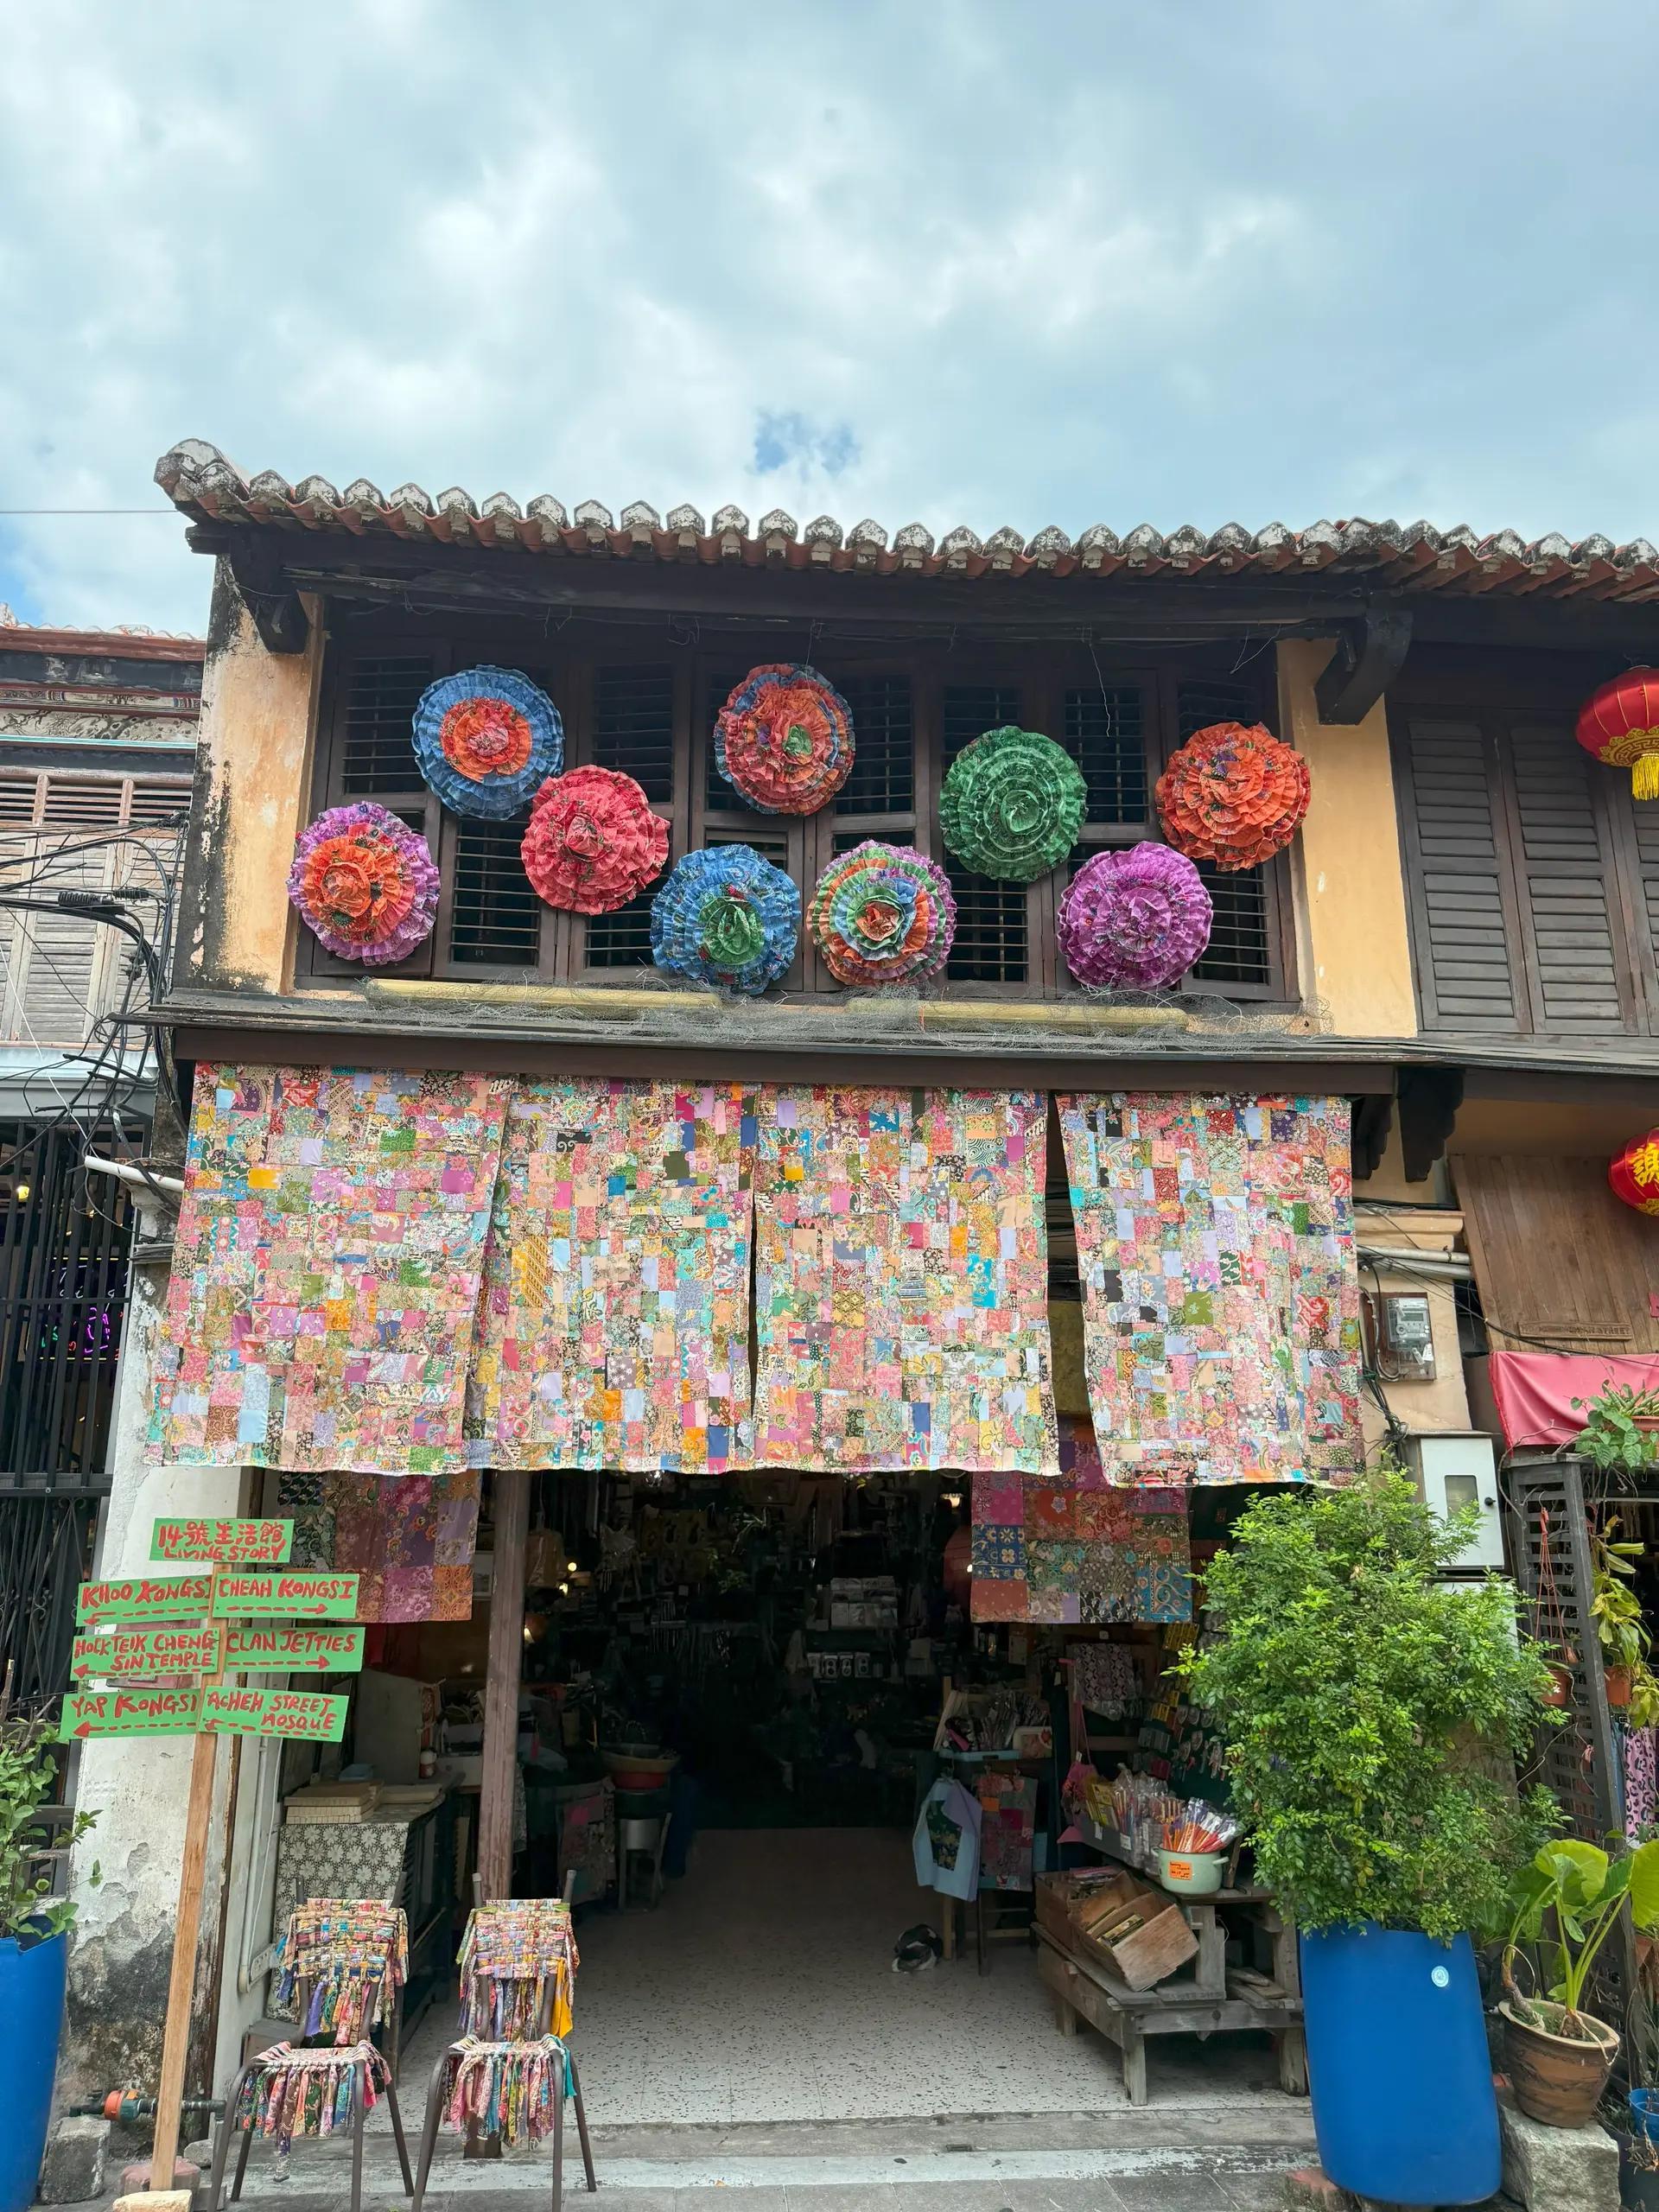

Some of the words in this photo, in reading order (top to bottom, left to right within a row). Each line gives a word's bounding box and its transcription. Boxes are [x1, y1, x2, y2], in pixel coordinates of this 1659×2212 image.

[158, 1521, 285, 1548] 14號生活館
[164, 1546, 226, 1560] LIVING
[227, 1539, 286, 1560] STORY
[81, 1583, 133, 1610] KHOO
[218, 1577, 272, 1598] CHEAH
[277, 1577, 356, 1599] KONGSI
[73, 1637, 111, 1659] HOCK
[111, 1633, 149, 1653] TEIK
[153, 1630, 216, 1652] CHENG
[226, 1631, 276, 1653] CLAN
[279, 1630, 357, 1653] JETTIES
[110, 1654, 144, 1672] SIN
[145, 1651, 214, 1669] TEMPLE
[71, 1695, 108, 1719] YAP
[114, 1693, 197, 1719] KONGSI
[207, 1690, 264, 1713] ACHEH
[269, 1694, 335, 1718] STREET
